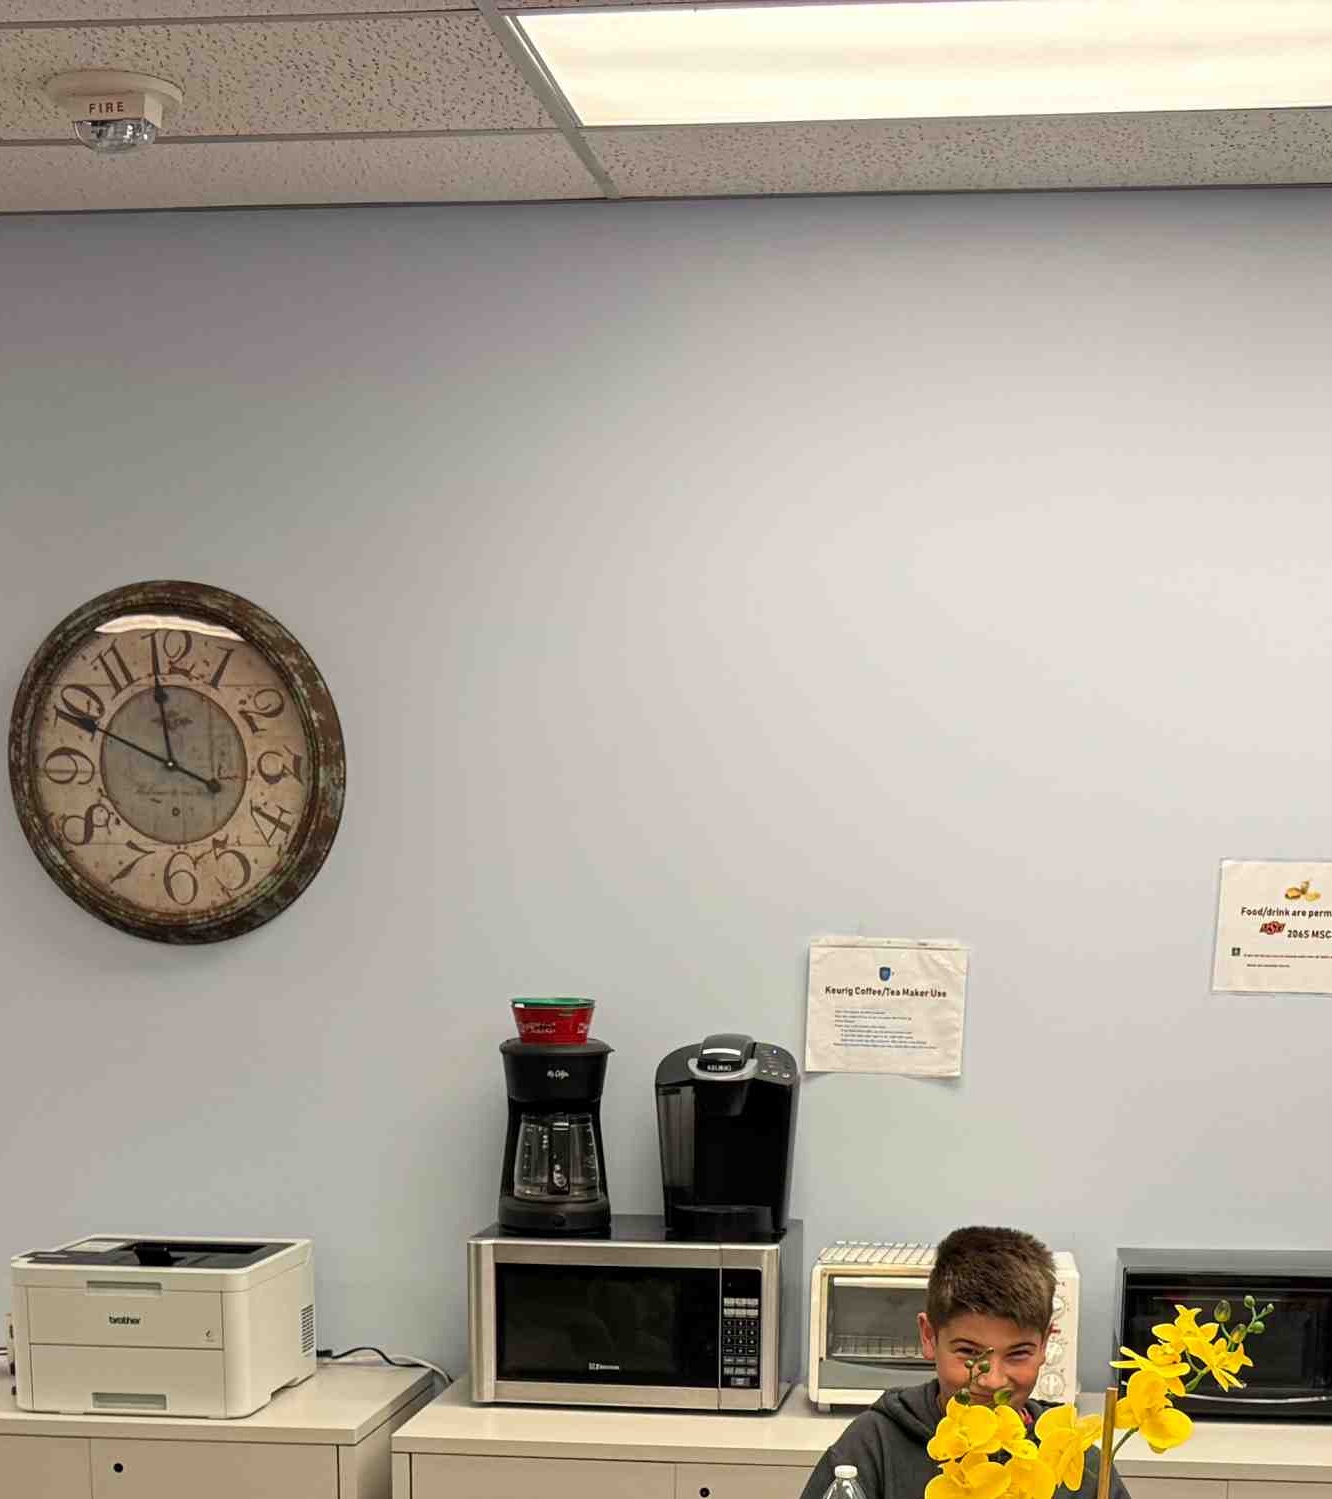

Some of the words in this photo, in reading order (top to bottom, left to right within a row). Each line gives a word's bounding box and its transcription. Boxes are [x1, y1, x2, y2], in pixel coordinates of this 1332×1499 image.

[89, 102, 124, 113] FIRE
[91, 640, 135, 699] 11
[141, 630, 195, 676] 12
[210, 646, 234, 688] 1
[238, 688, 284, 734] 2
[44, 747, 96, 784] 9
[257, 745, 304, 784] 3
[62, 800, 114, 845] 8
[250, 800, 293, 847] 4
[110, 840, 155, 883] 7
[164, 850, 200, 905] 6
[212, 834, 251, 899] 5
[1241, 906, 1290, 918] Food/drink
[1292, 910, 1306, 918] are
[825, 985, 853, 996] Keurig
[854, 986, 901, 998] Coffee/Tea
[902, 987, 928, 997] Maker
[930, 989, 947, 998] Use
